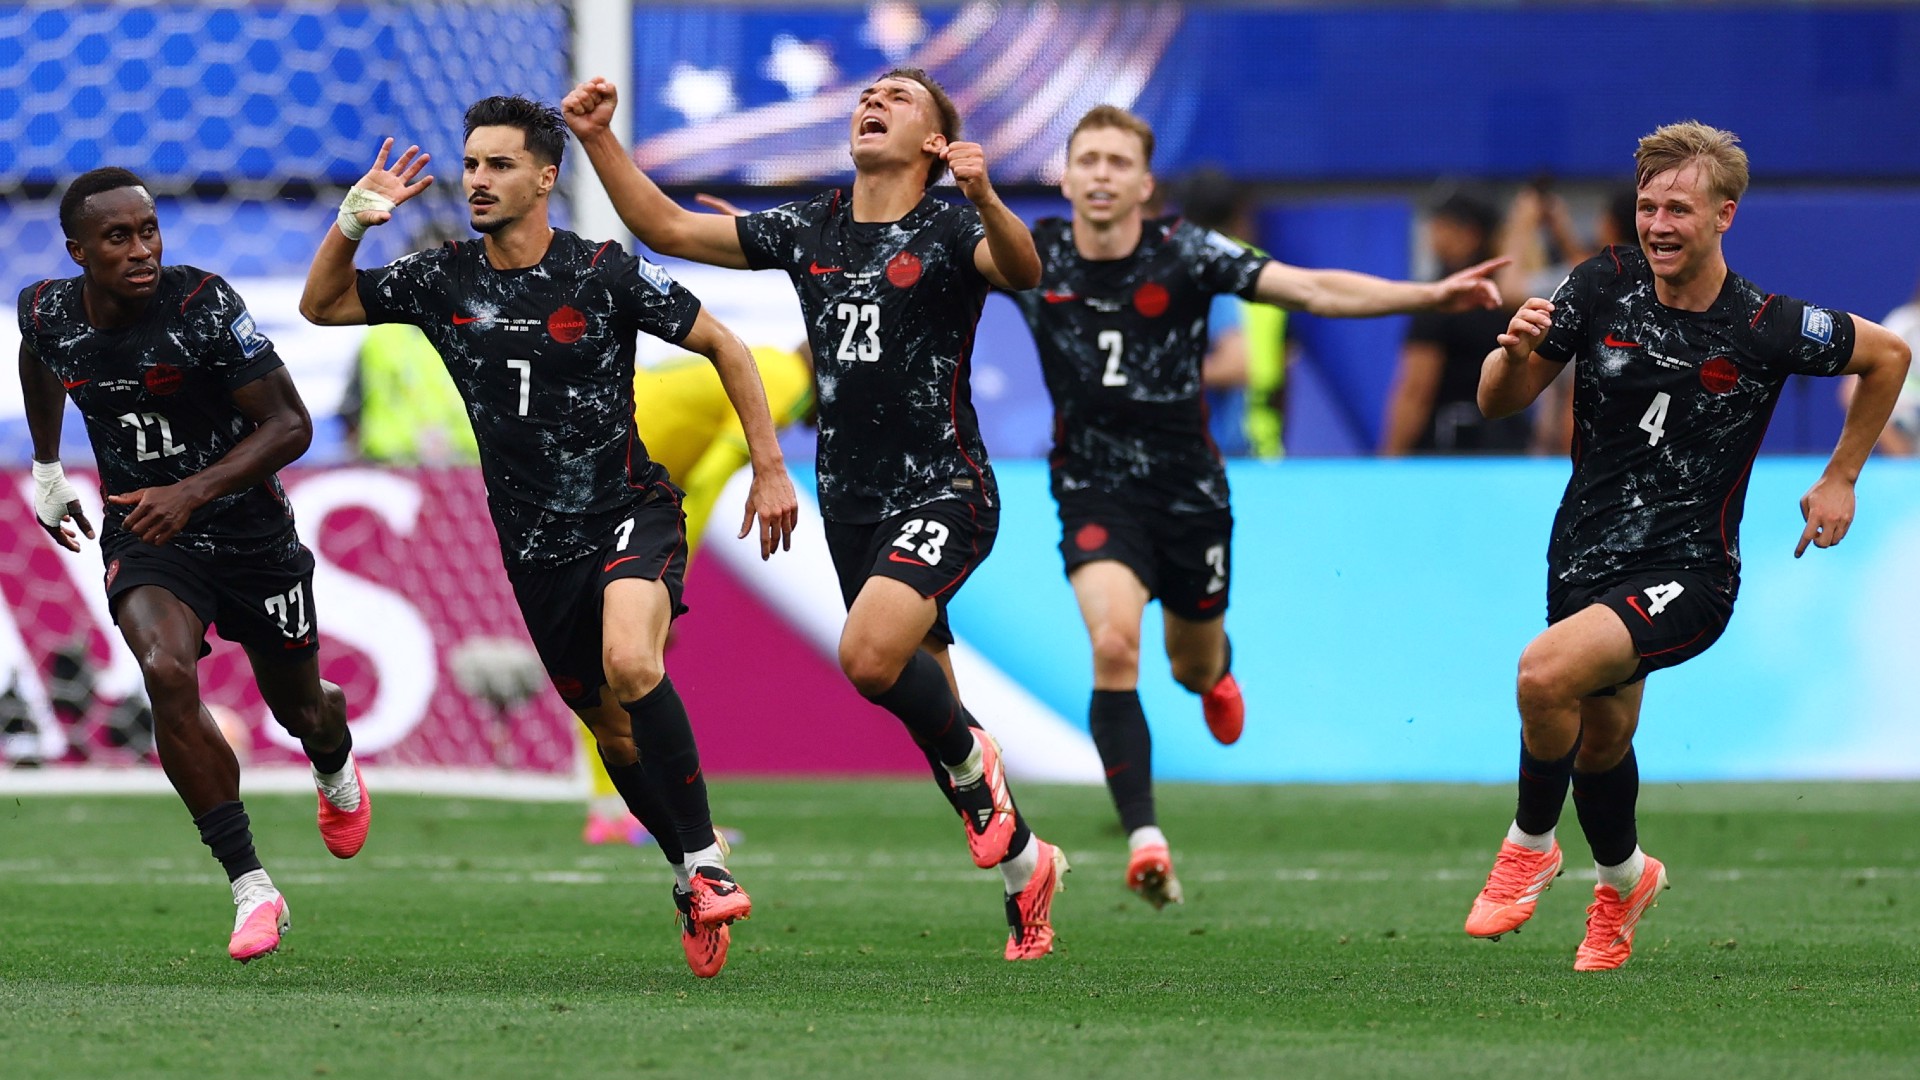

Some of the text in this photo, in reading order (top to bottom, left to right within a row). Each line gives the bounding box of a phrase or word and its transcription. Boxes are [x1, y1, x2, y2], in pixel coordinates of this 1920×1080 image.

[550, 321, 584, 329] CANADA
[836, 302, 881, 363] 23
[1097, 330, 1128, 387] 2
[506, 359, 531, 416] 7
[117, 412, 187, 462] 22
[1638, 391, 1671, 447] 4
[892, 518, 949, 566] 23
[264, 580, 310, 639] 22
[1643, 580, 1685, 617] 4
